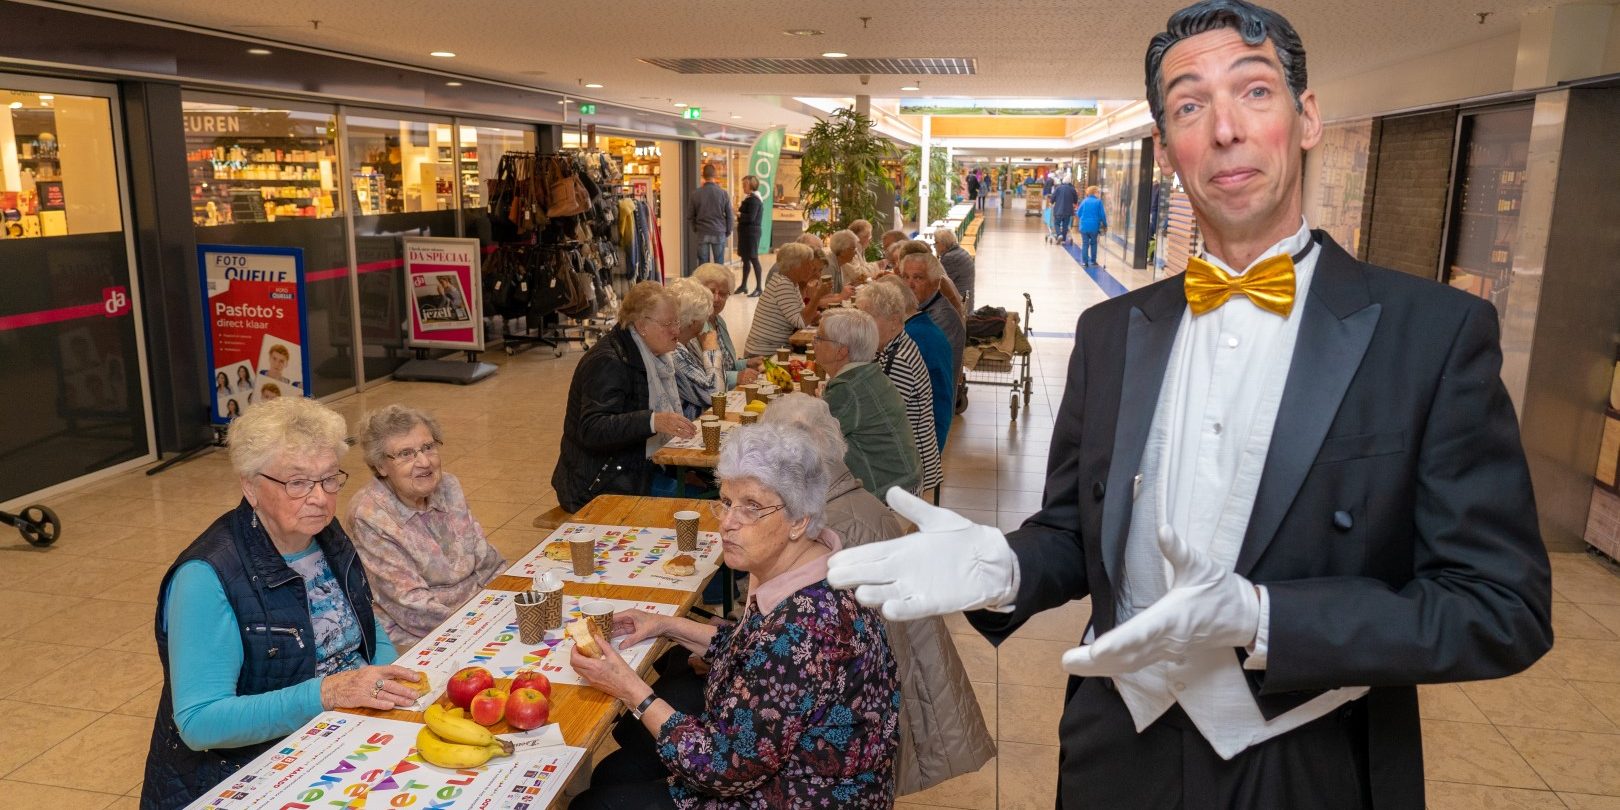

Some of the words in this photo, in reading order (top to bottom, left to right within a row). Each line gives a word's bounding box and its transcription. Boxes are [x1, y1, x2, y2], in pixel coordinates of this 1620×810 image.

[216, 256, 247, 266] FOTO
[409, 251, 424, 261] DA
[426, 252, 471, 262] SPECIAL
[105, 290, 126, 313] da
[216, 319, 244, 328] direct
[245, 321, 269, 329] klaar
